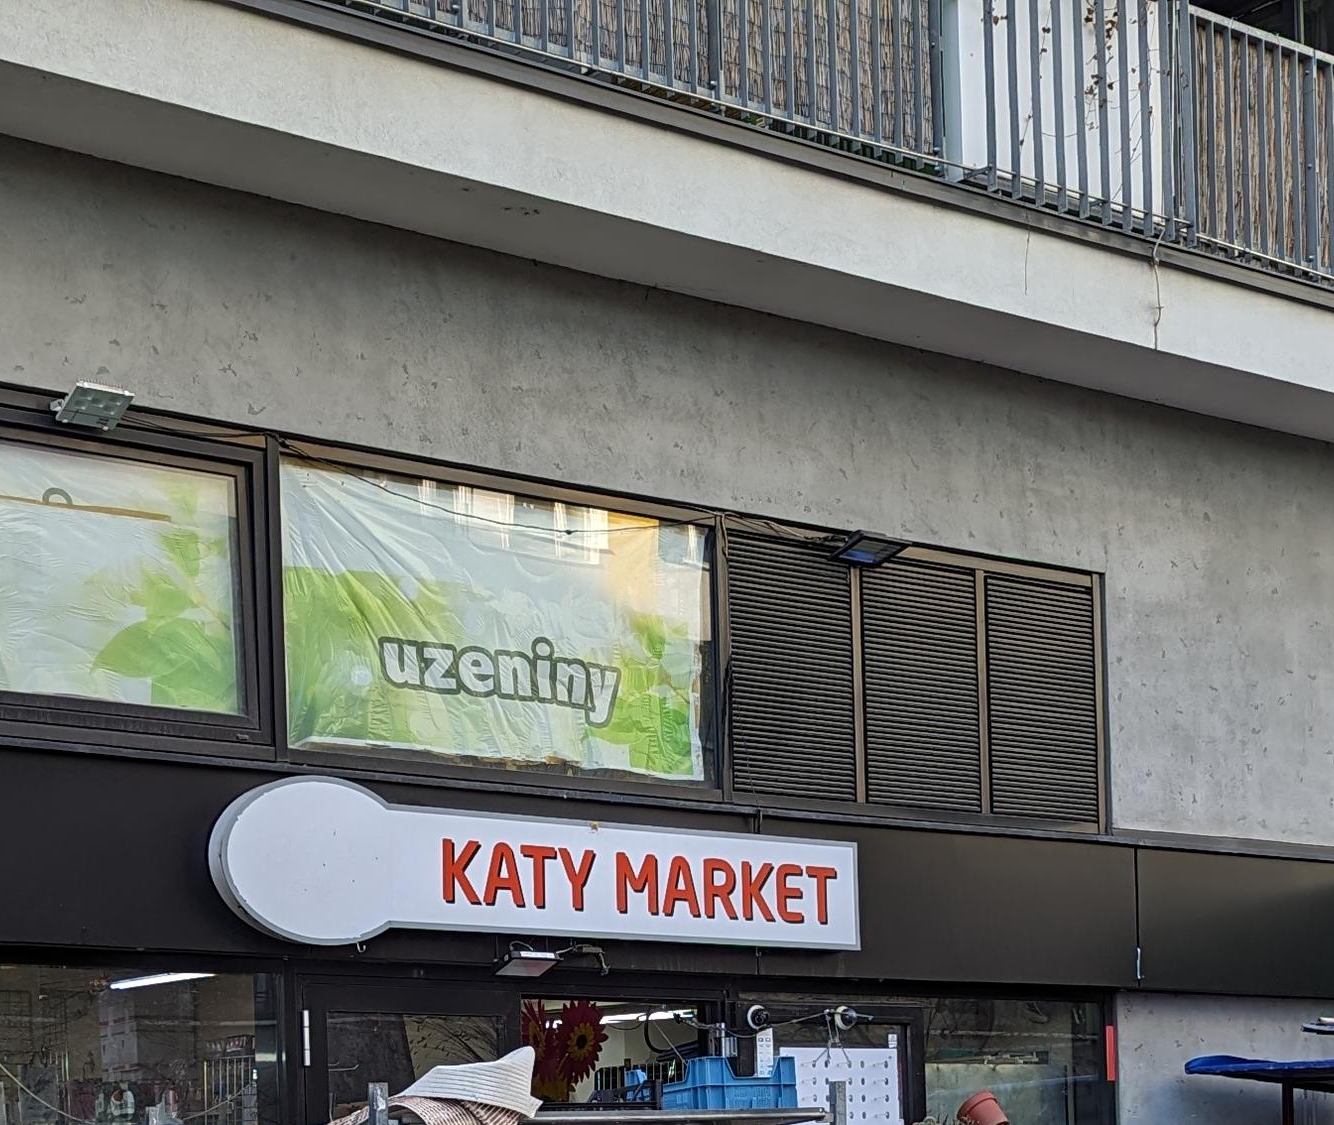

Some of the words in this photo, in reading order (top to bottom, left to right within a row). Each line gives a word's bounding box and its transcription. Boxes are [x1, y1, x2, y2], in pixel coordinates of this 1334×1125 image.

[378, 636, 620, 728] uzeniny
[442, 838, 595, 911] KATY
[616, 852, 837, 925] MARKET
